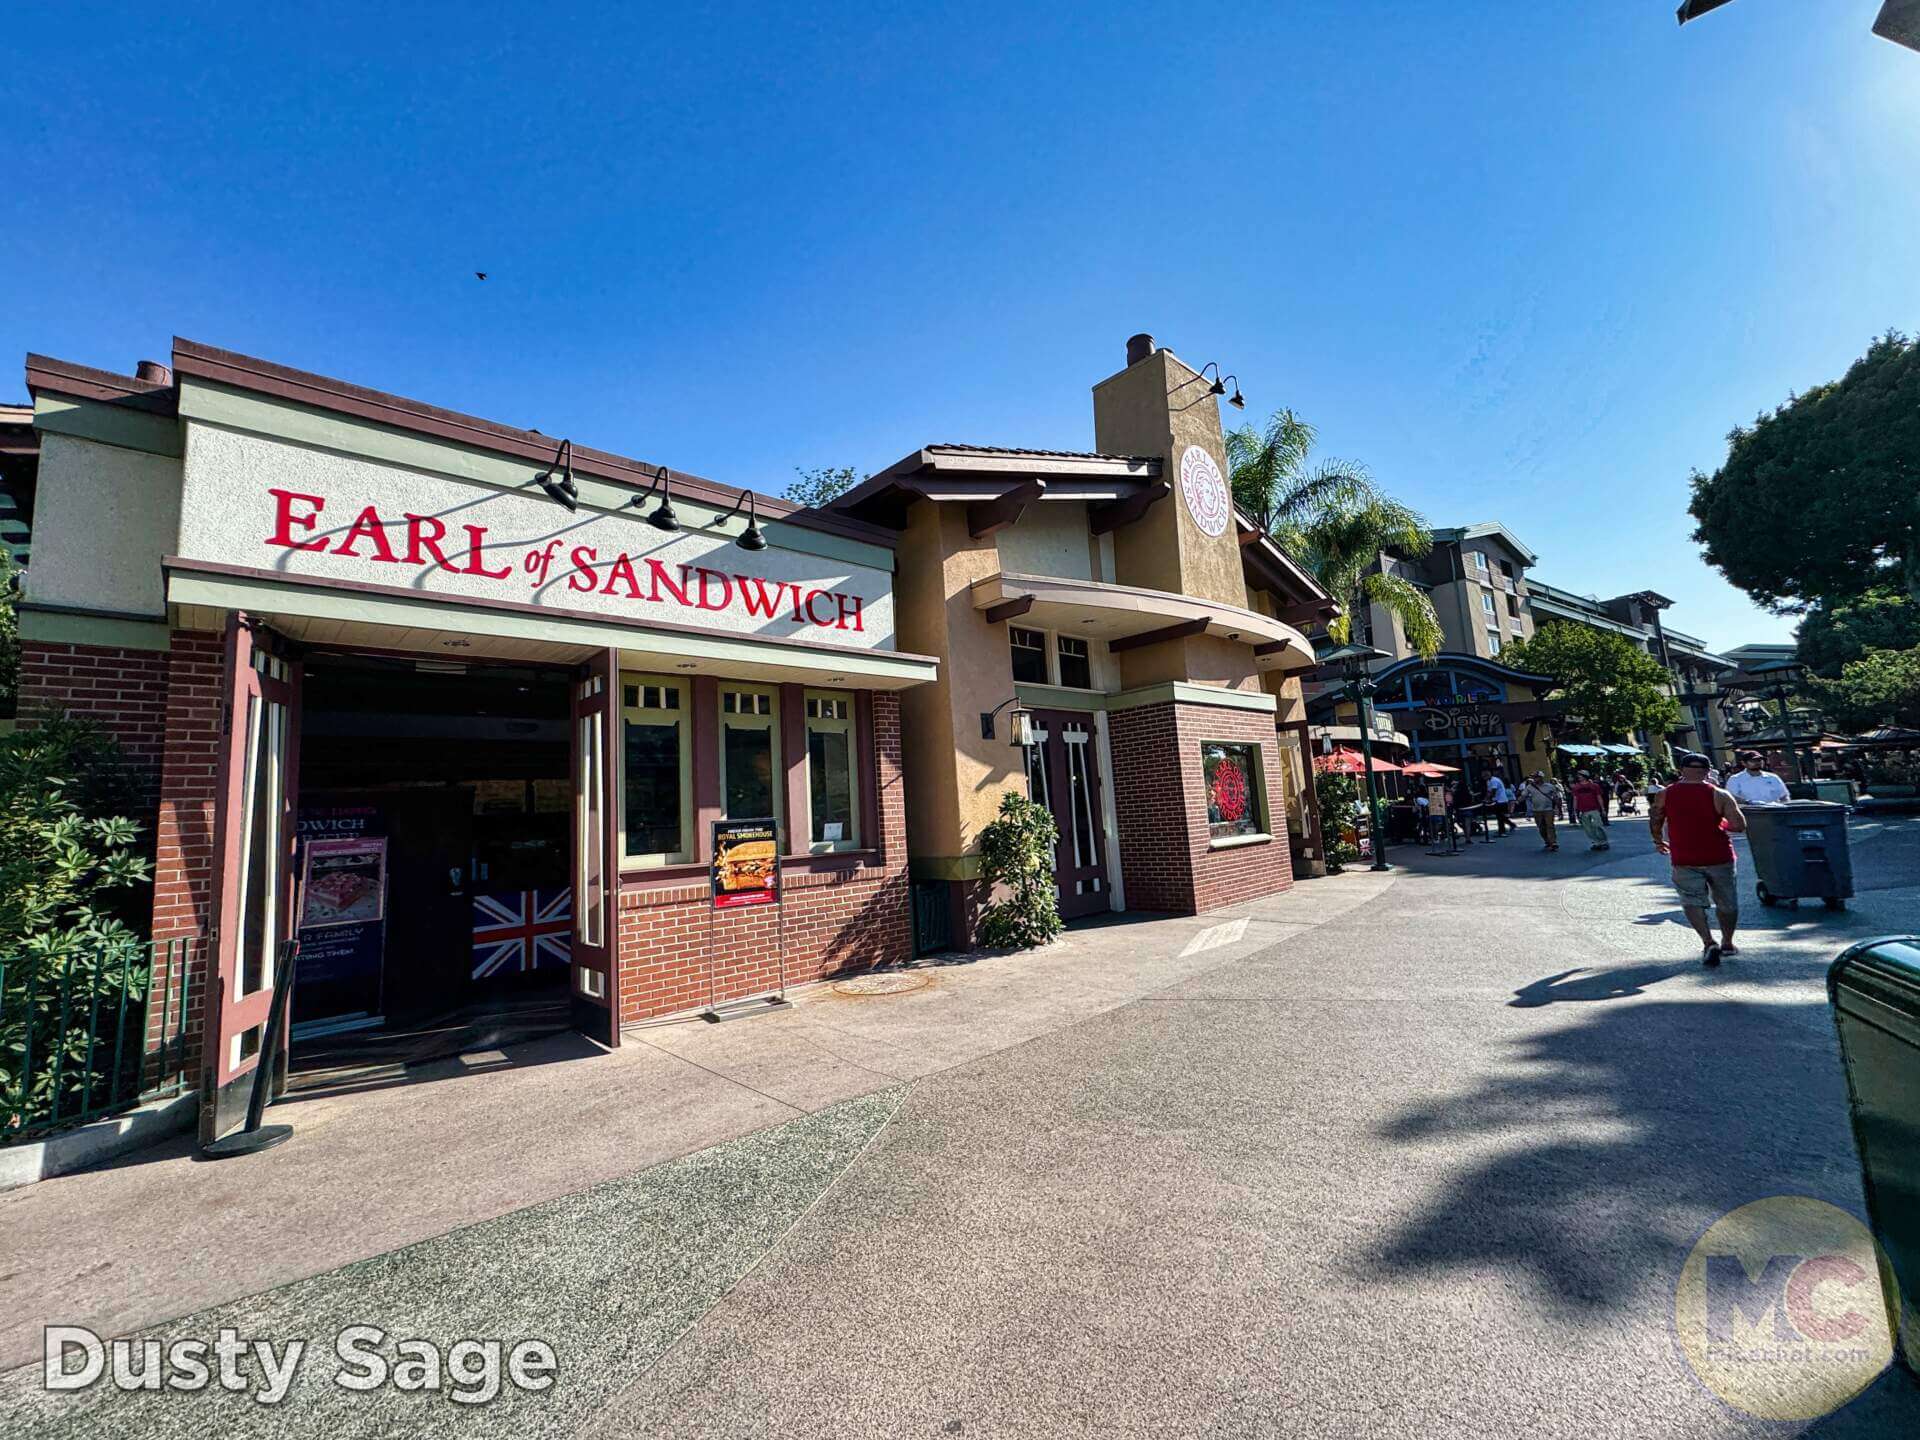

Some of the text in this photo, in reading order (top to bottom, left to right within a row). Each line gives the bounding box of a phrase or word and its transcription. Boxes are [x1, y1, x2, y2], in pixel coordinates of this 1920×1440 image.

[1184, 448, 1209, 470] EARL
[1185, 487, 1228, 534] SANDWICH
[265, 487, 864, 633] EARL of SANDWICH
[1425, 692, 1489, 705] WORLD
